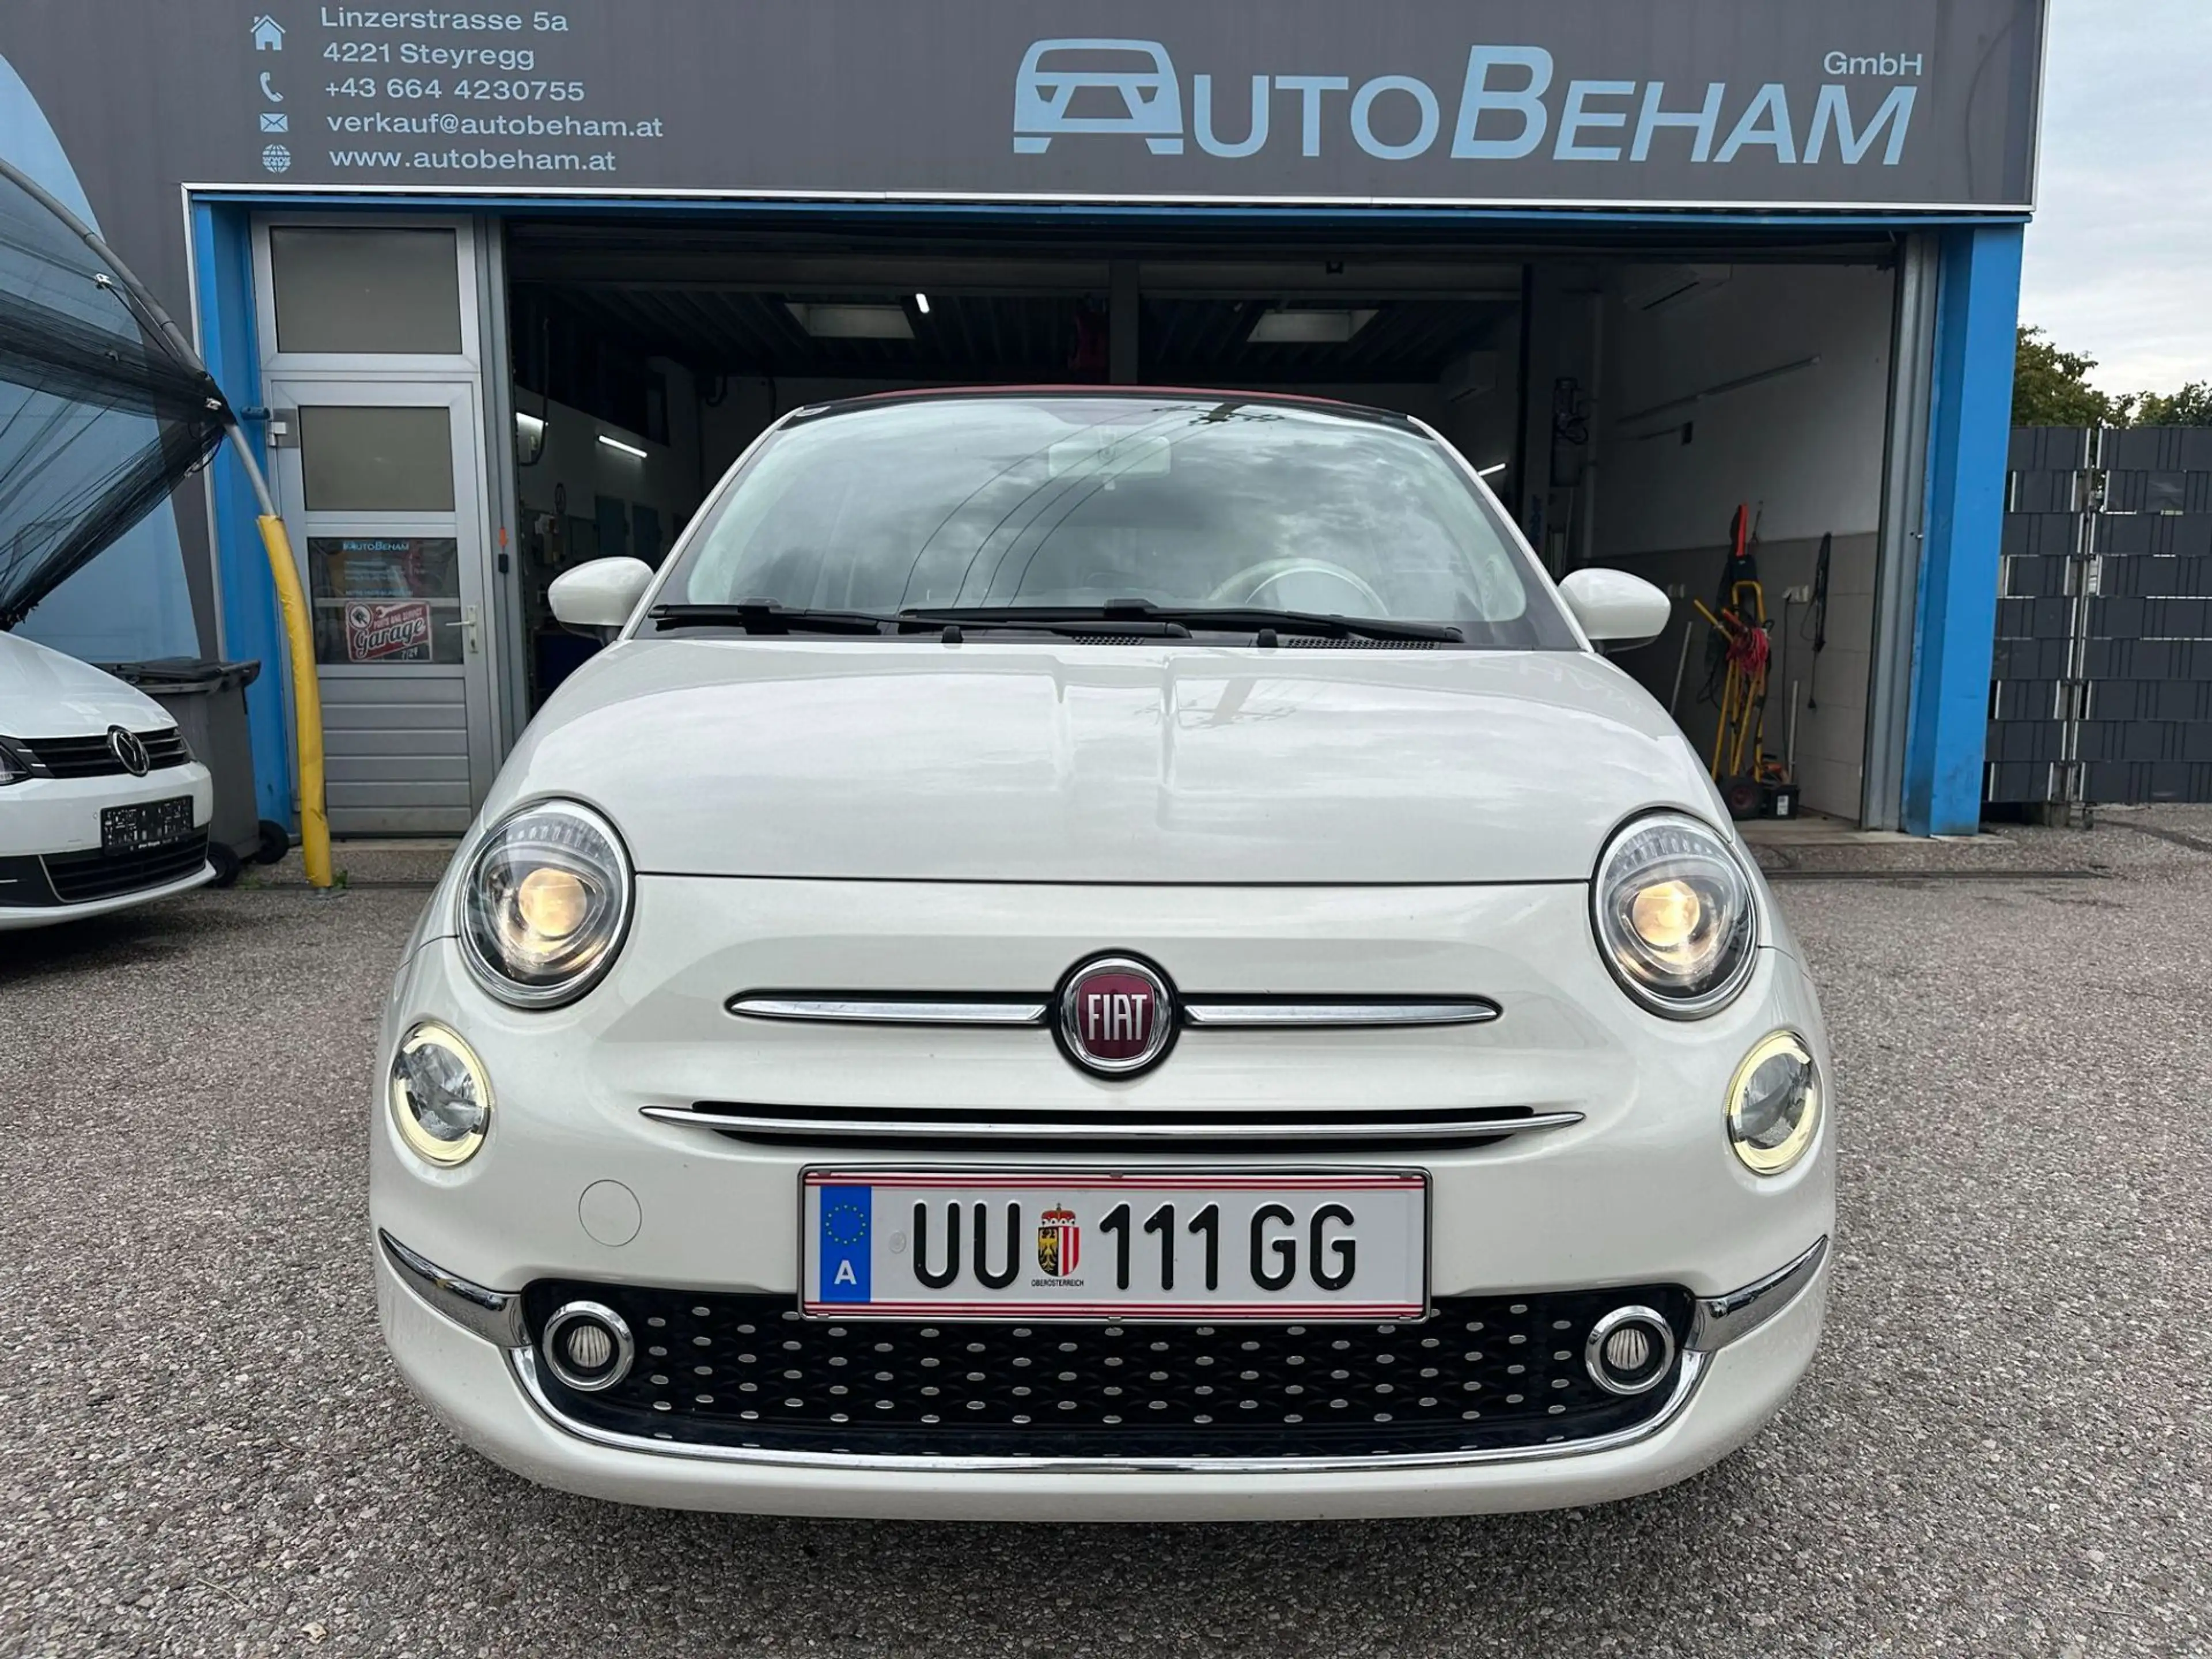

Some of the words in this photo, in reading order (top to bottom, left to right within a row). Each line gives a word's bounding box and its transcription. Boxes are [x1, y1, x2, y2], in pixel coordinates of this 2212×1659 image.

[320, 6, 522, 31] Linzerstrasse
[533, 11, 569, 32] 5a
[323, 42, 390, 63] 4221
[400, 43, 535, 71] Steyregg
[1824, 51, 1922, 76] GmbH
[325, 77, 377, 98] +43
[387, 78, 442, 99] 664
[454, 79, 585, 101] 4230755
[327, 112, 664, 137] verkauf@autobeham.at
[329, 149, 616, 171] www.autobeham.at
[1088, 994, 1148, 1040] FIAT
[834, 1260, 857, 1284] A
[913, 1203, 1020, 1290] UU
[1099, 1204, 1219, 1291] 111
[1250, 1204, 1357, 1291] GG
[1031, 1278, 1084, 1287] OBERÖSTERREICH
